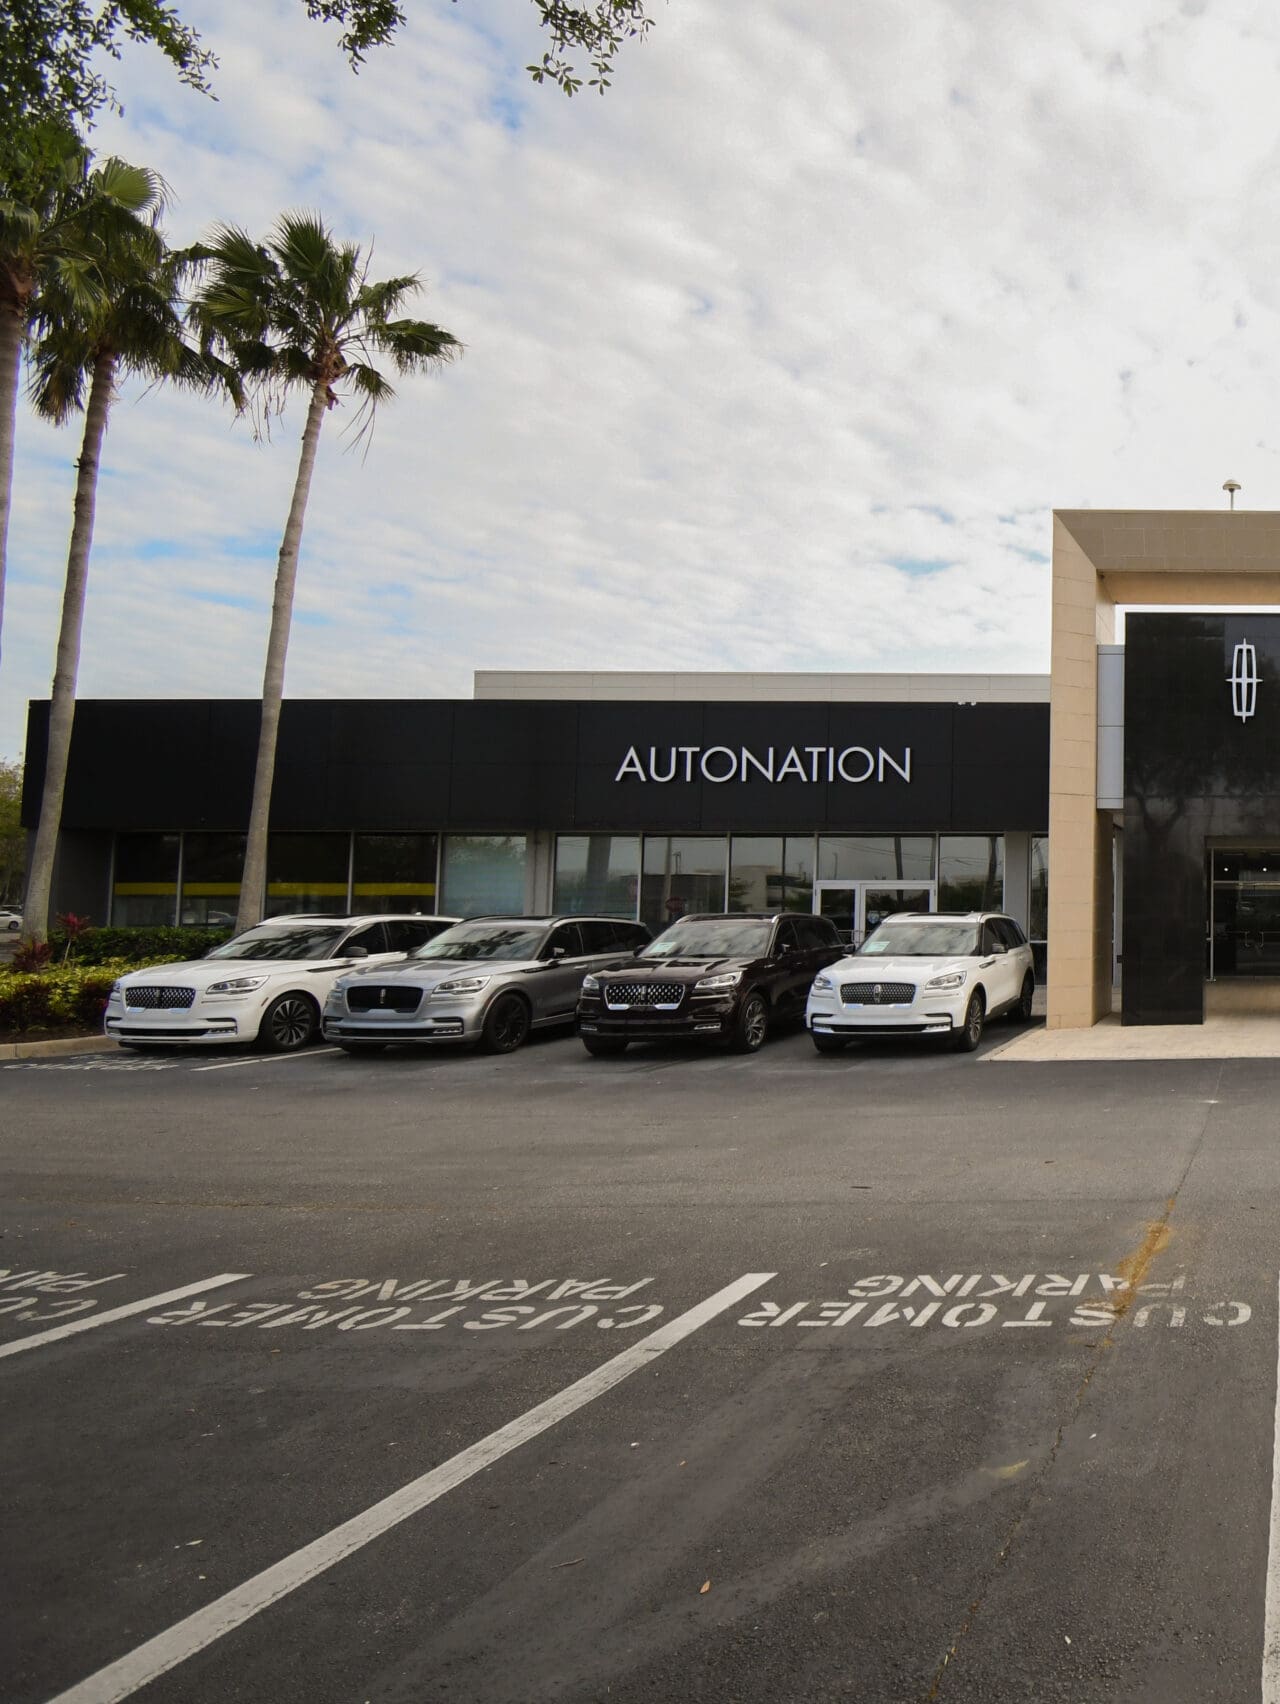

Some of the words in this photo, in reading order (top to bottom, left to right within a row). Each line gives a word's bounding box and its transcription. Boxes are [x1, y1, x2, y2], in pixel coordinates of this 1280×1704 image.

[614, 745, 911, 783] AUTONATION
[297, 1278, 655, 1301] PARKING
[848, 1274, 1186, 1298] PARKING
[147, 1302, 664, 1331] CUSTOMER
[738, 1302, 1252, 1328] CUSTOMER
